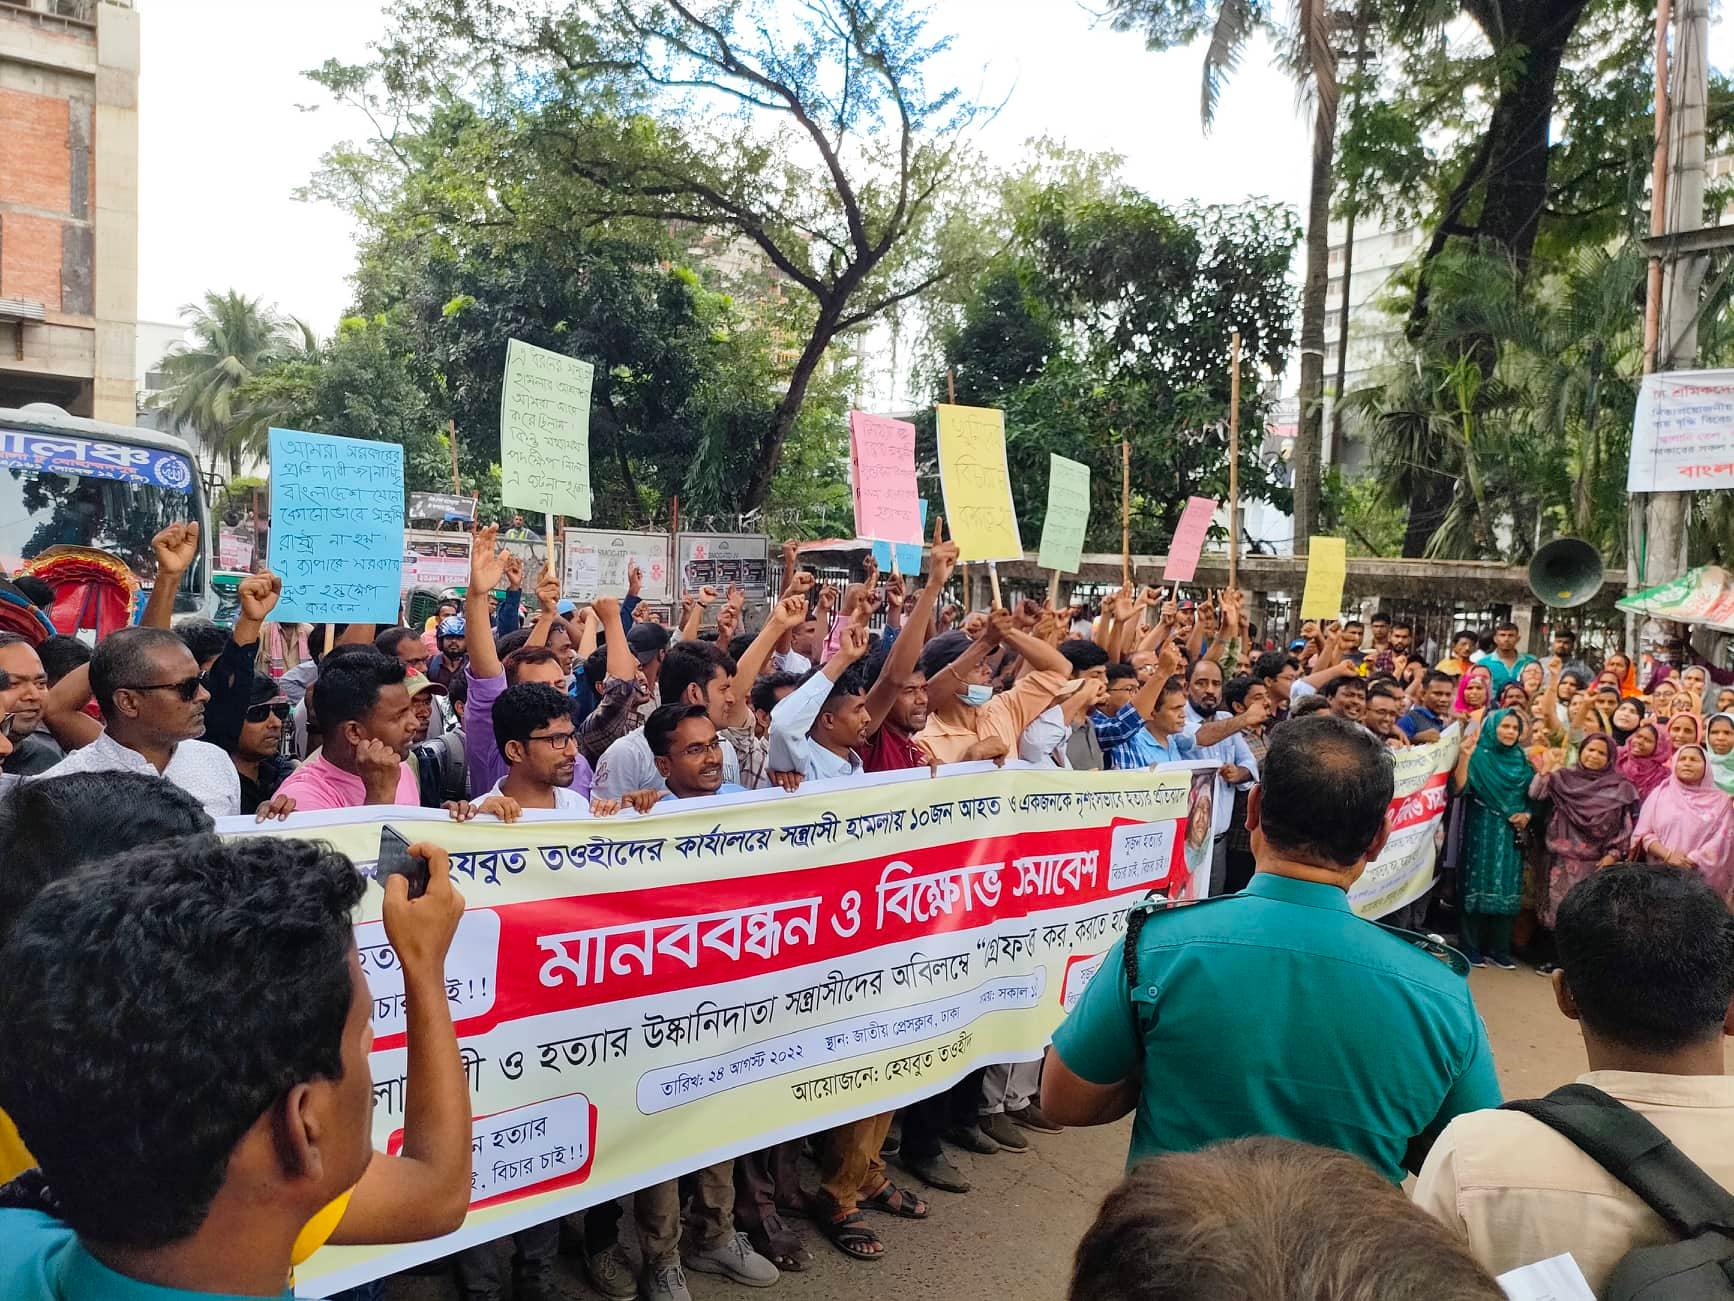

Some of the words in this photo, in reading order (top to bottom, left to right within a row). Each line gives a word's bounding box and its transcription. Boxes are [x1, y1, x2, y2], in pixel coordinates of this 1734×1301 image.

[279, 440, 338, 460] আমরা
[279, 461, 317, 478] প্রতি
[279, 483, 370, 506] বাংলাদেশ
[329, 533, 353, 546] না
[272, 559, 288, 578] এ
[296, 557, 350, 577] ব্যাপারে
[536, 836, 668, 871] তওহীদের
[674, 823, 776, 860] কার্যালয়ে
[779, 811, 842, 848] সন্ত্রাসী
[846, 809, 906, 841] হামলায়
[909, 801, 955, 832] ১০জন
[958, 795, 1002, 822] আহত
[1019, 792, 1073, 815] একজনকে
[1123, 788, 1154, 811] হত্যার
[536, 895, 823, 988] মানববন্ধন
[831, 889, 862, 938] ও
[875, 860, 1006, 930] বিক্ষোভ
[499, 1050, 525, 1080] ও
[536, 1037, 632, 1074] হত্যার
[784, 969, 885, 1016] সন্ত্রাসীদের
[891, 951, 970, 989] অবিলম্বে
[1074, 913, 1110, 944] করতে
[660, 1073, 704, 1097] তারিখ:
[707, 1065, 725, 1083] ২৪
[728, 1050, 767, 1076] আগস্ট
[769, 1044, 804, 1066] ২০২২
[824, 1034, 850, 1051] স্থান:
[852, 1022, 889, 1045] জাতীয়
[940, 1005, 961, 1023] ঢাকা
[997, 986, 1029, 1001] সকাল
[791, 1066, 879, 1104] আয়োজনে:
[884, 1050, 934, 1082] হেযবুত
[491, 1115, 549, 1154] হত্যার
[491, 1157, 534, 1185] বিচার
